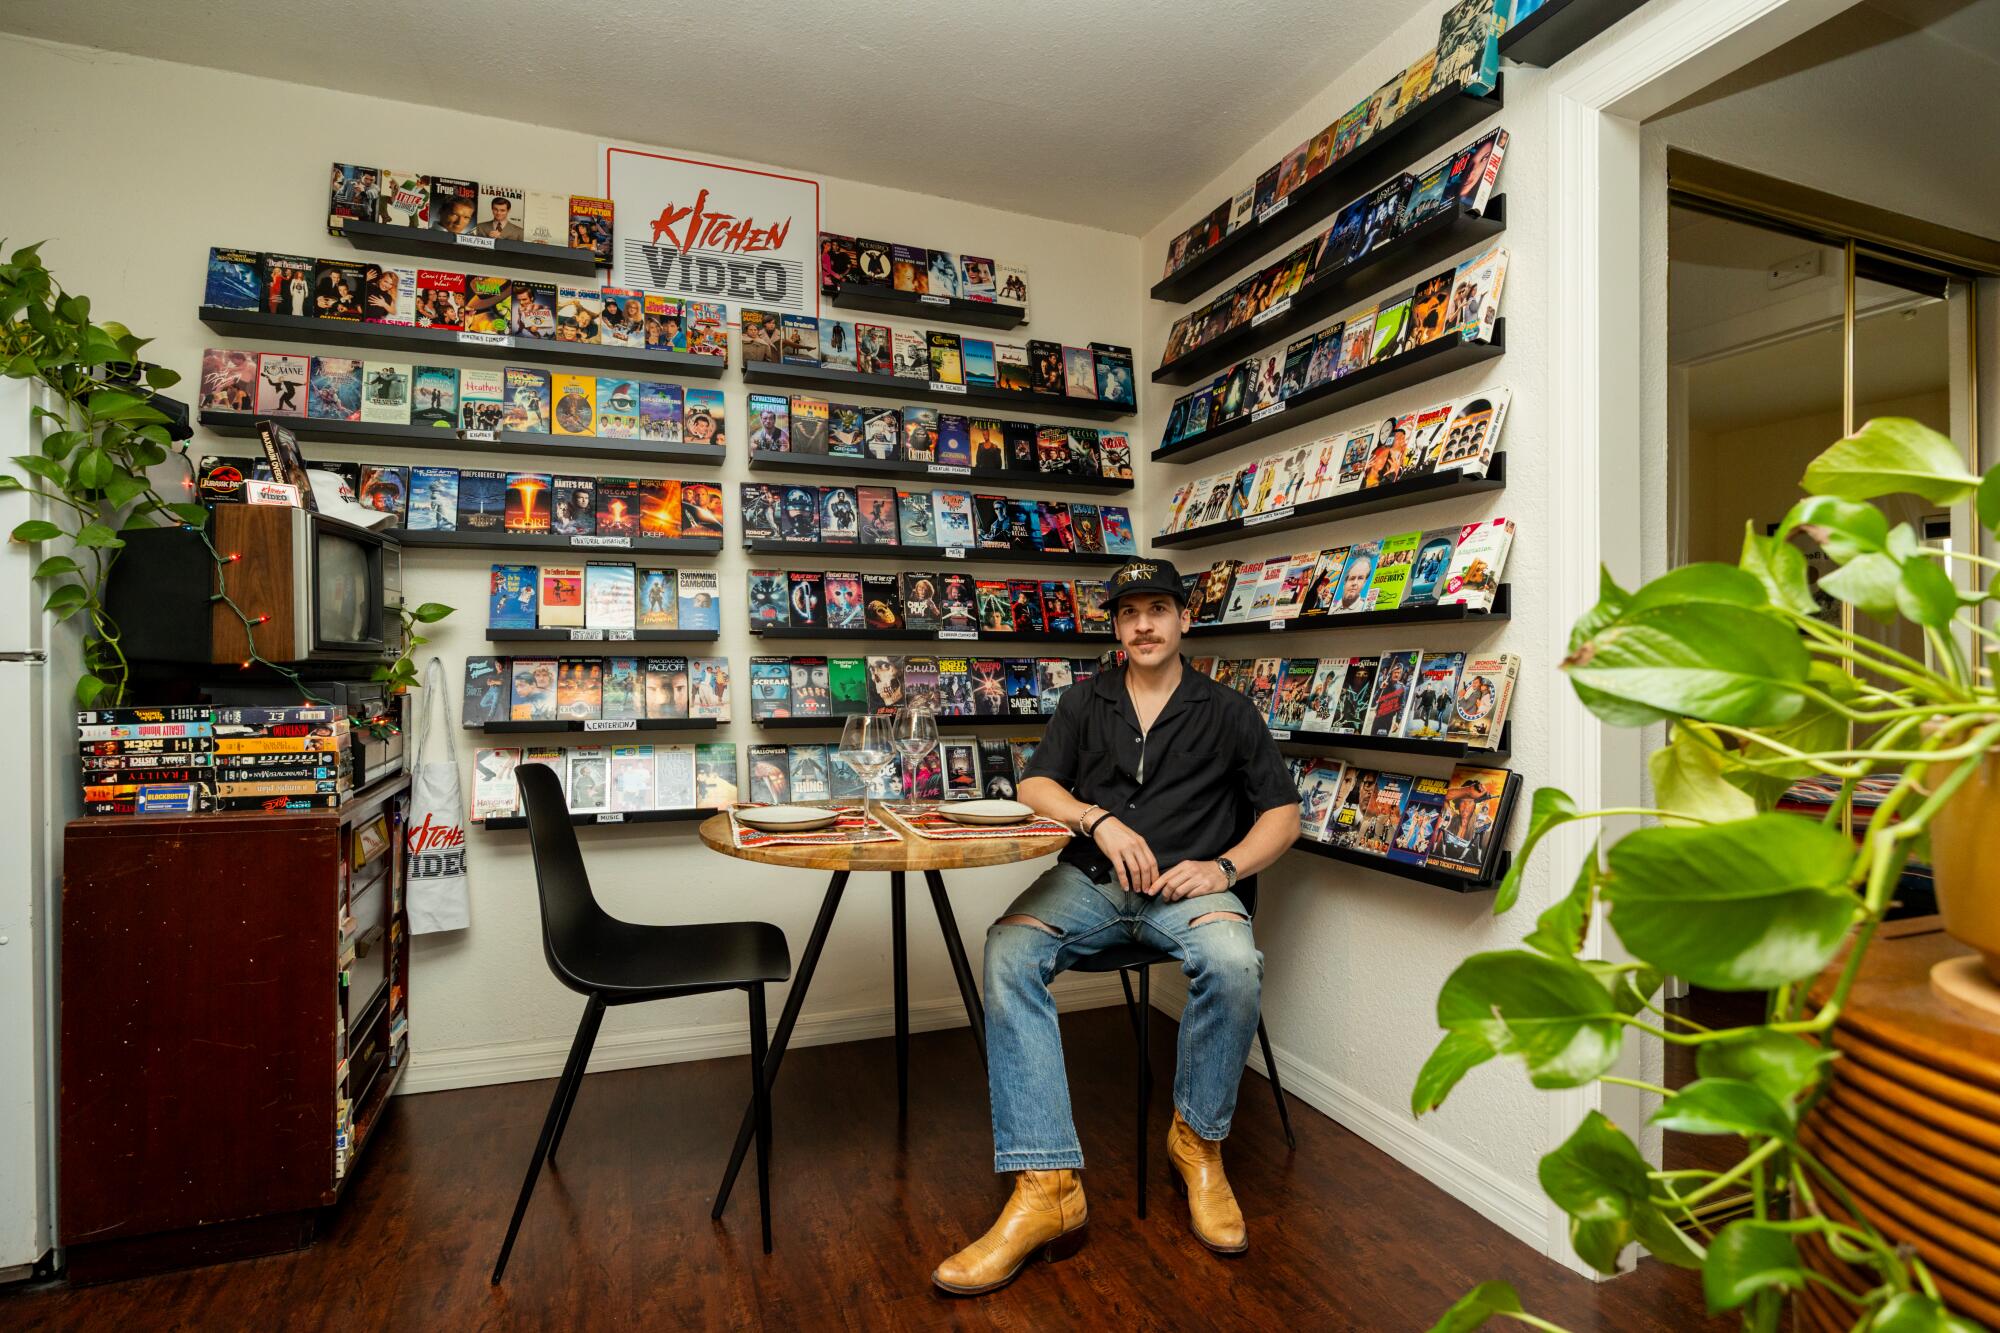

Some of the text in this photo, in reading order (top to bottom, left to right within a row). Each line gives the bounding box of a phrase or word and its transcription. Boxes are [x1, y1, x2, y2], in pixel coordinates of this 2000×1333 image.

[436, 183, 454, 195] True
[481, 188, 522, 200] LIAR LIAR
[573, 205, 612, 217] PULP FICTION
[650, 189, 792, 255] KITCHEN
[641, 245, 788, 302] VIDEO
[263, 365, 303, 377] ROXANNE
[465, 381, 503, 393] Heathers
[751, 395, 787, 404] SCHWARZENEGGER
[751, 403, 788, 413] PREDATOR
[261, 431, 275, 462] MAXIMUM
[461, 471, 496, 479] INDEPENDENCE
[203, 480, 229, 488] JURASSIC
[554, 479, 593, 490] DANTE'S PEAK
[260, 492, 288, 502] VIDEO
[599, 488, 638, 496] VOLCANO
[512, 517, 549, 528] CORE
[1239, 562, 1265, 574] FARGO
[680, 572, 717, 581] SWIMMING
[1373, 573, 1405, 585] SIDEWAYS
[680, 580, 717, 588] CAMBODIA
[907, 600, 928, 609] CHILD'S
[911, 607, 925, 617] PLAY
[648, 663, 686, 672] FACE/OFF
[939, 659, 967, 667] NIGHT
[905, 664, 938, 673] C.H.U.D.
[753, 678, 790, 686] SCREAM
[1010, 697, 1038, 708] SALEM'S
[268, 711, 285, 721] E.T.
[273, 724, 309, 737] DESPERADO
[592, 721, 630, 730] CRITERION
[138, 725, 186, 737] LEGALLY blonde
[124, 740, 164, 749] ROCK
[130, 757, 159, 765] JUSTICE
[128, 771, 189, 781] FRAILTY
[257, 785, 274, 793] plan
[795, 780, 825, 793] THING
[1417, 785, 1449, 796] EXPRESS
[147, 793, 189, 801] BLOCKBUSTER
[600, 814, 621, 822] MUSIC
[408, 812, 465, 856] KITCHE
[1439, 860, 1456, 870] TICKET
